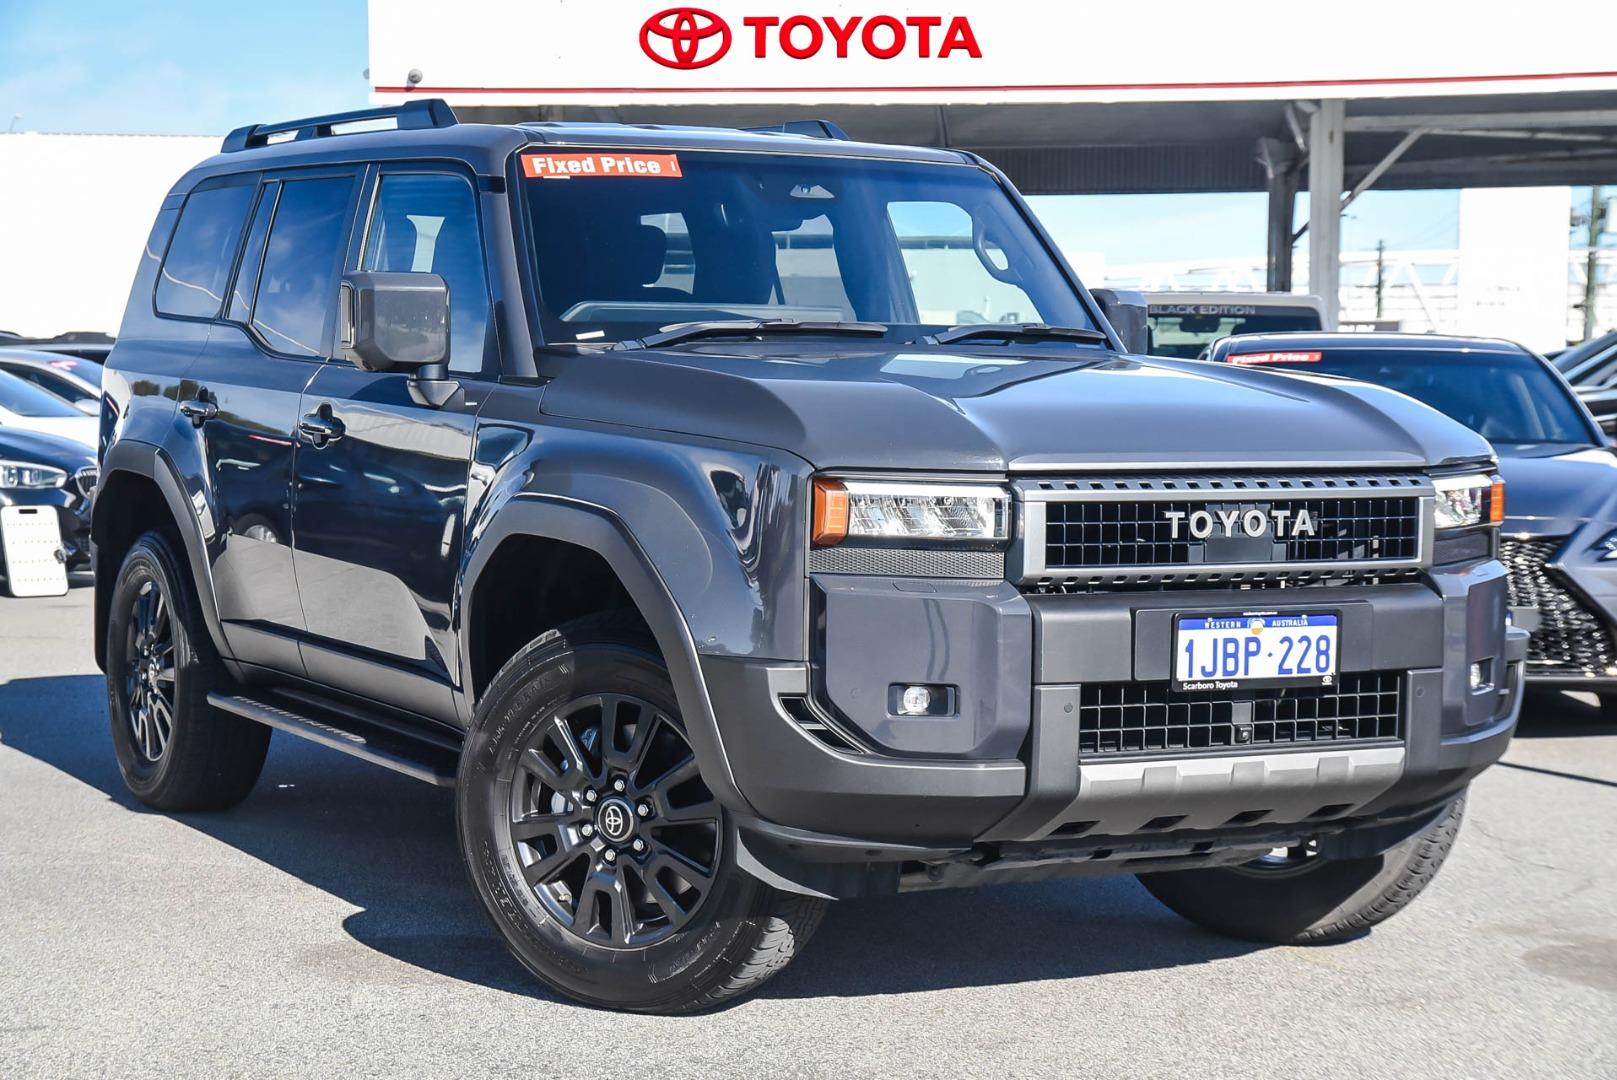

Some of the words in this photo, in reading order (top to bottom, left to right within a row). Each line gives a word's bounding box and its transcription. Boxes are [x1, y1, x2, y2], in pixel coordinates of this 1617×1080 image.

[743, 15, 983, 60] TOYOTA
[532, 157, 596, 174] Fixed
[600, 156, 661, 174] Price
[1149, 305, 1197, 315] BLACK
[1199, 305, 1256, 315] EDITION
[1272, 352, 1310, 362] Price
[1164, 509, 1315, 539] TOYOTA
[1204, 620, 1242, 629] WESTERN
[1271, 618, 1309, 627] AUSTRALIA
[1183, 681, 1215, 690] Scarboro
[1215, 680, 1239, 690] Toyota
